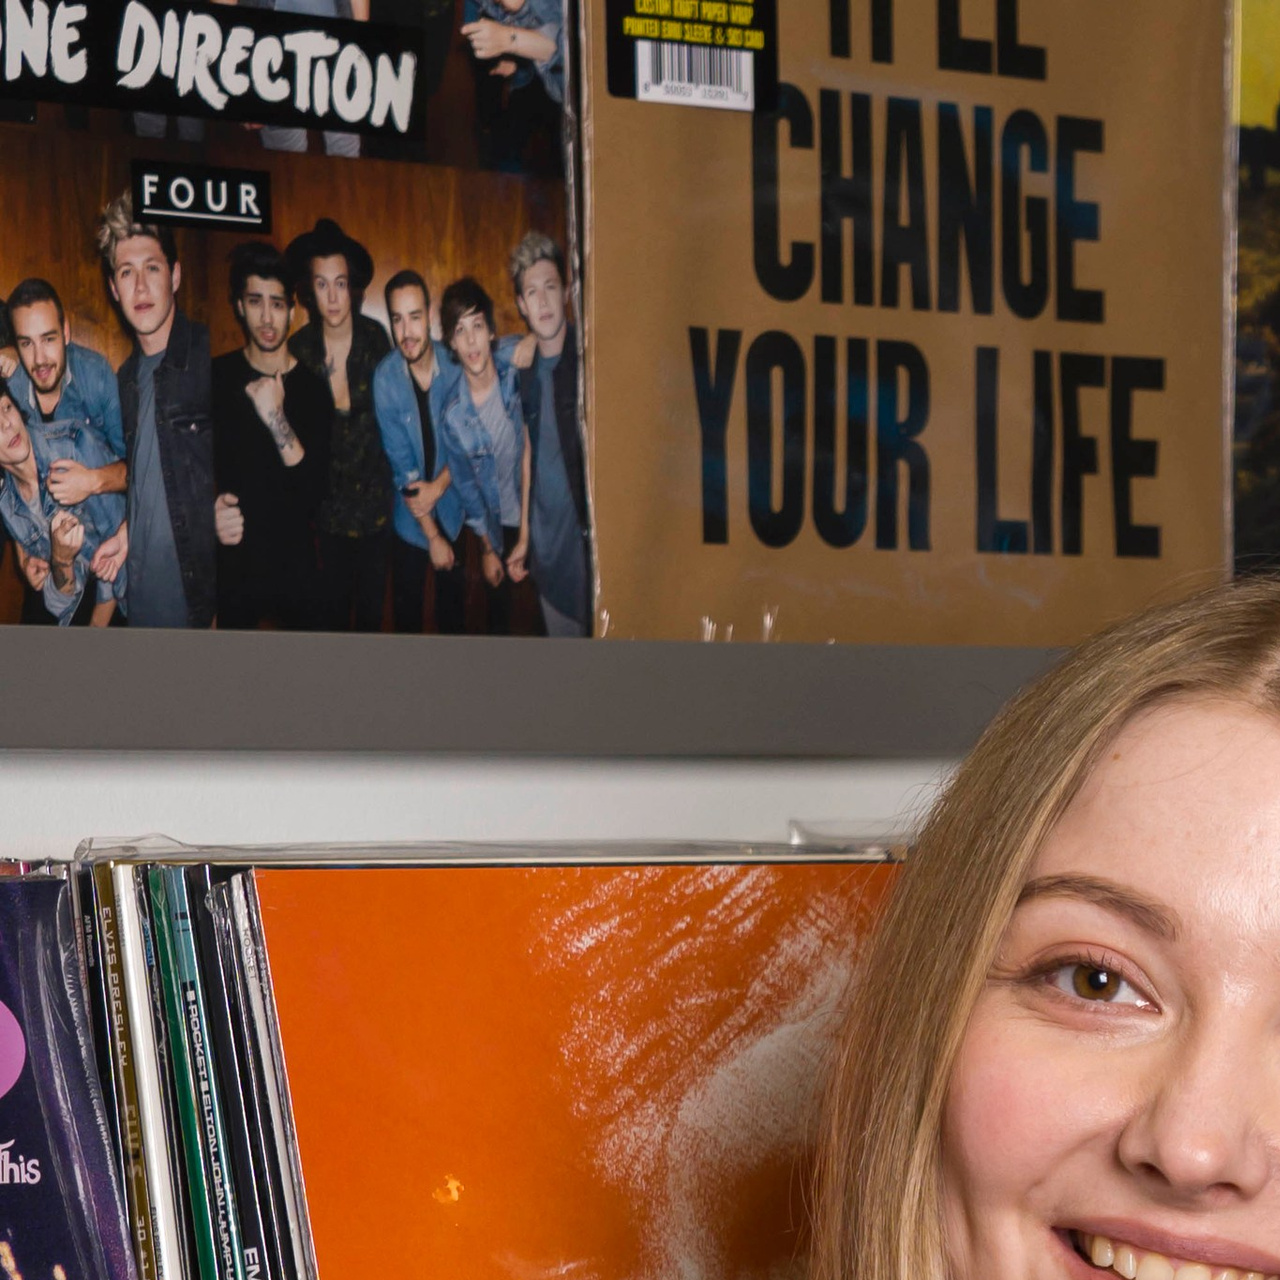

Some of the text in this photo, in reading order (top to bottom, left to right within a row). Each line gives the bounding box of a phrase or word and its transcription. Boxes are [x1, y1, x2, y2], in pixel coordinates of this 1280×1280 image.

[0, 0, 416, 132] NE DIRECTION
[142, 174, 261, 216] FOUR
[752, 81, 1106, 324] CHANGE
[687, 326, 1168, 559] YOUR LIFE
[102, 907, 118, 966] ELVIS
[110, 973, 128, 1067] PRESLEY
[189, 1005, 208, 1081] ROCKET
[202, 1094, 217, 1152] ELTON
[211, 1155, 226, 1205] JOHN
